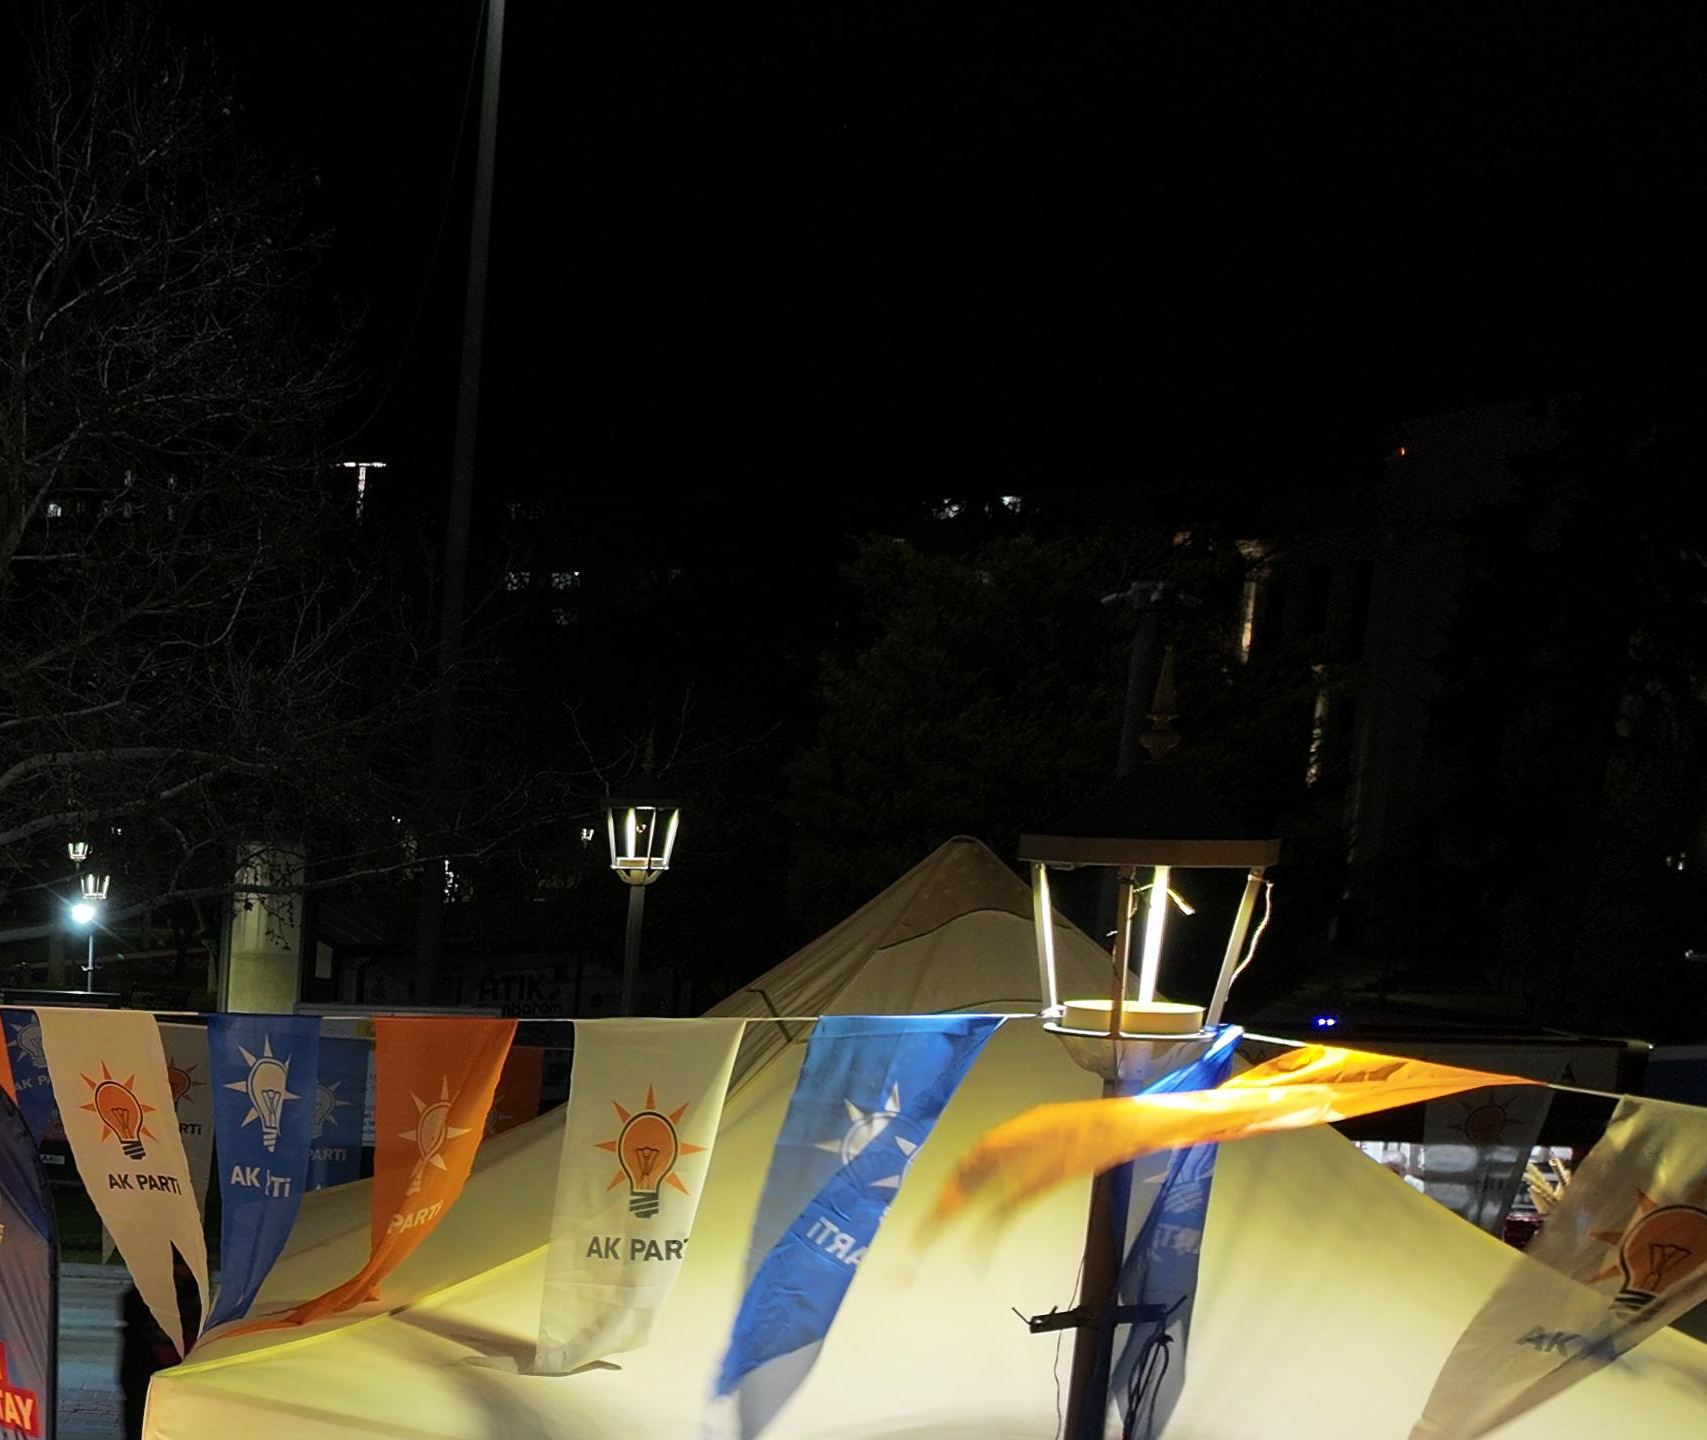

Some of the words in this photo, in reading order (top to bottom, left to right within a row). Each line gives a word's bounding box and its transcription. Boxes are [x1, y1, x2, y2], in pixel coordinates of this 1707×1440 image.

[109, 1174, 133, 1191] AK
[230, 1165, 261, 1188] AK
[586, 1236, 621, 1260] AK
[630, 1238, 689, 1262] PAR
